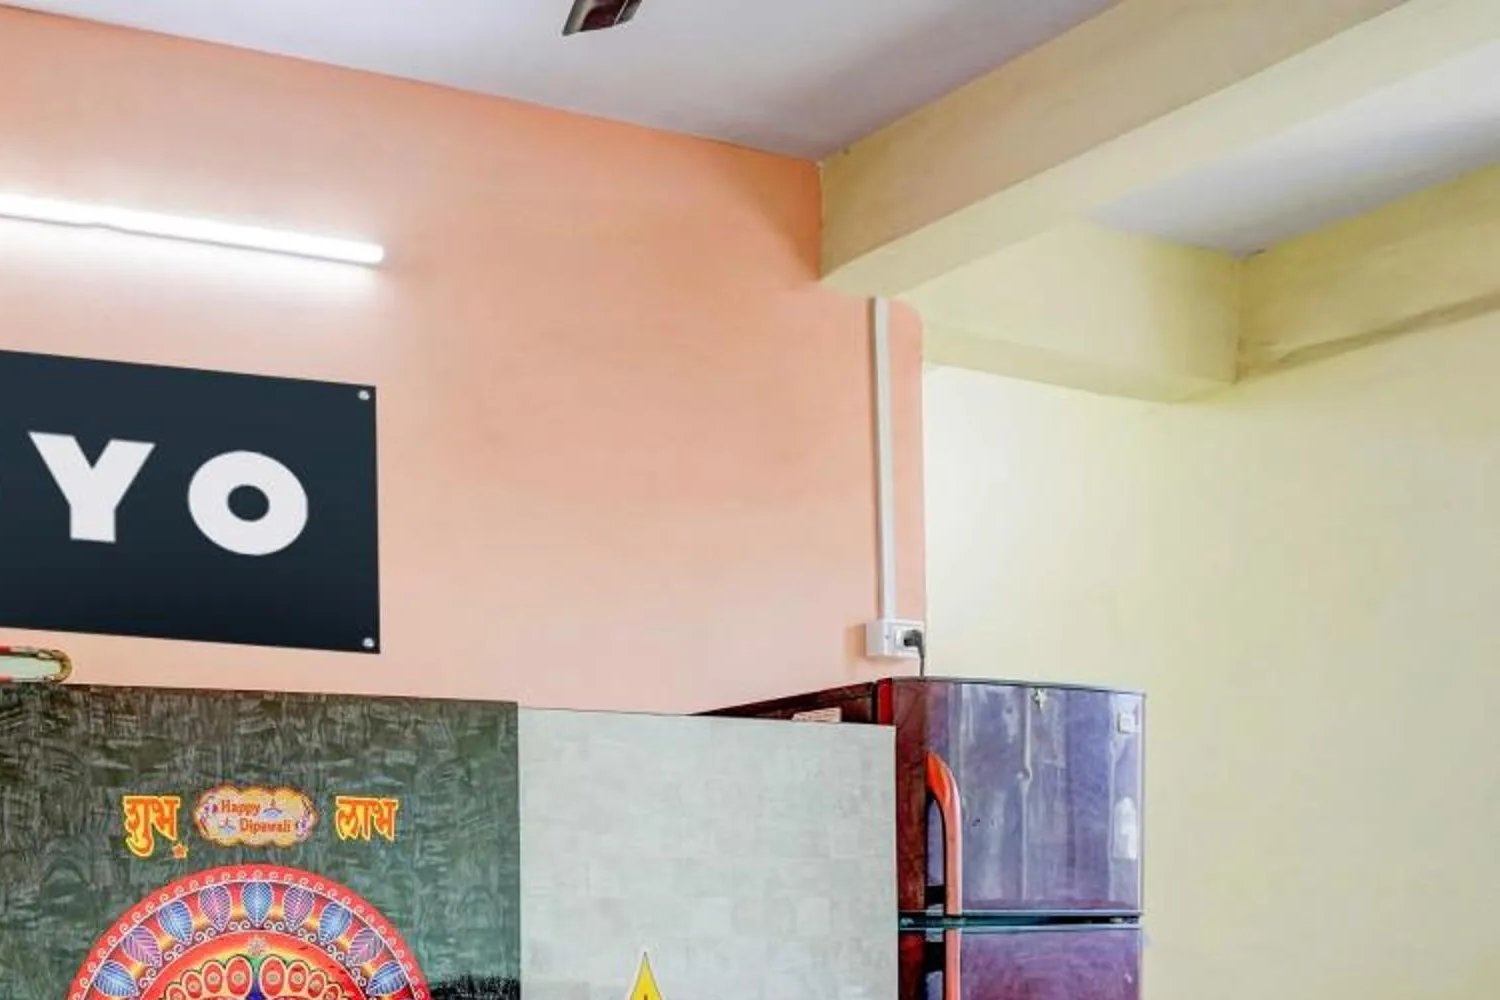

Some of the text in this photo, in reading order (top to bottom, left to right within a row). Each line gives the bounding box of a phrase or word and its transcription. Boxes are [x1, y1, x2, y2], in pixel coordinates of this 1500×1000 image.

[221, 799, 260, 817] Happy
[336, 796, 398, 841] लाभ
[123, 796, 180, 856] शुभ
[240, 818, 293, 834] Dipawali
